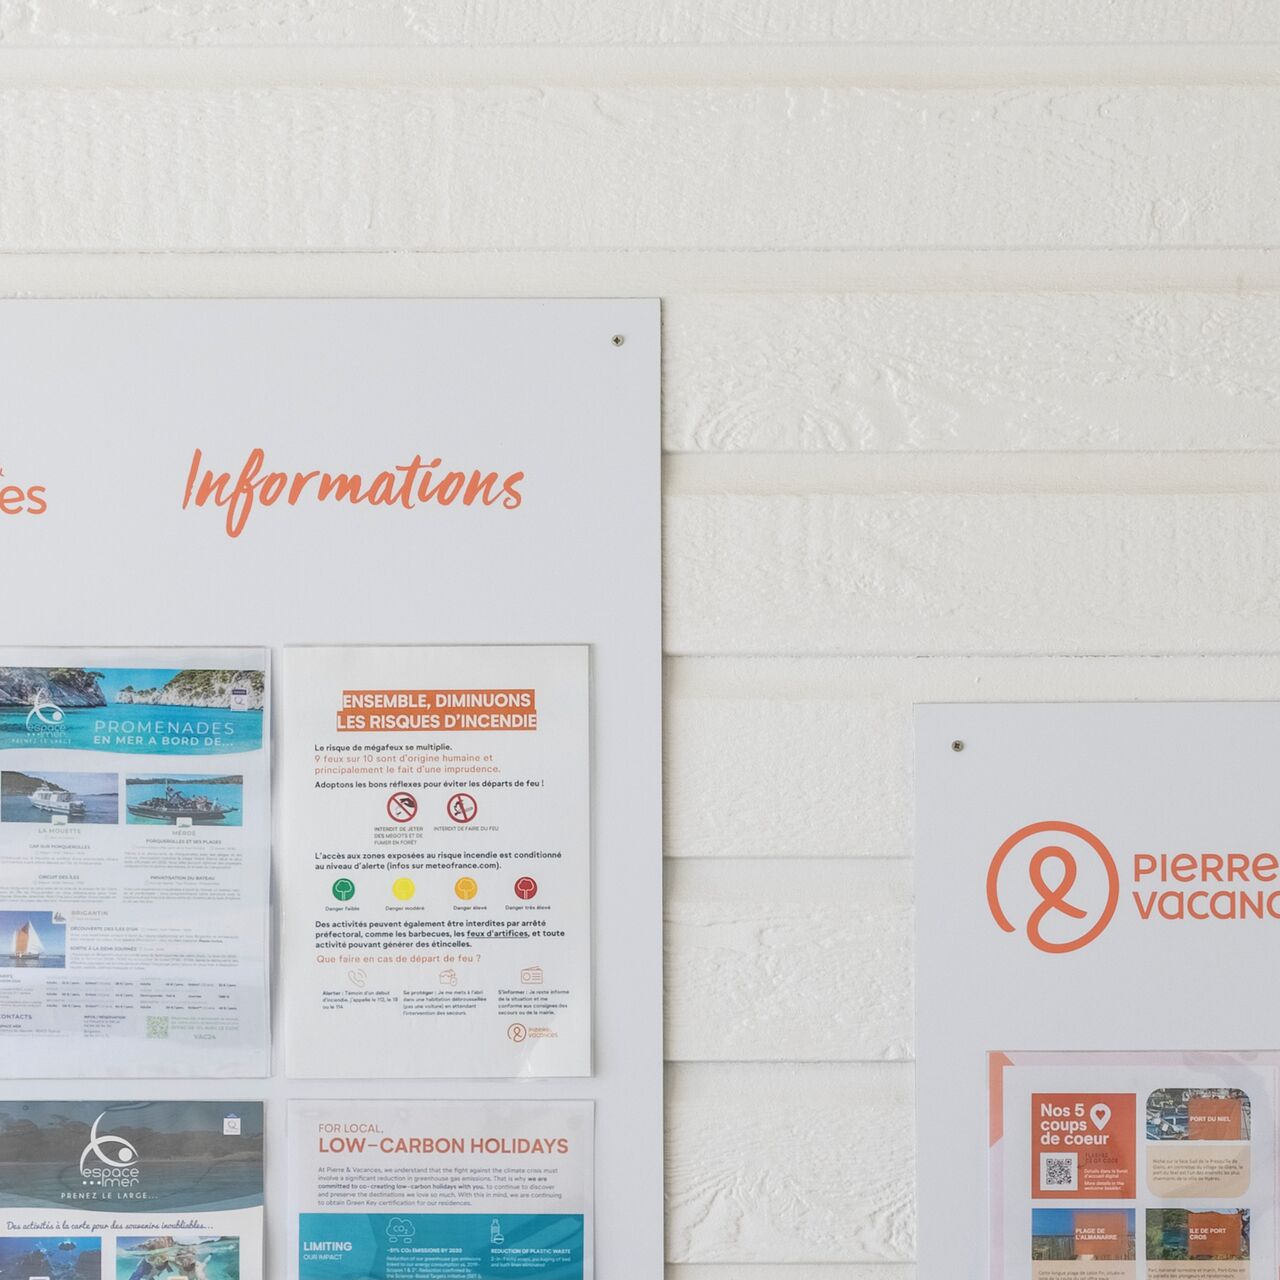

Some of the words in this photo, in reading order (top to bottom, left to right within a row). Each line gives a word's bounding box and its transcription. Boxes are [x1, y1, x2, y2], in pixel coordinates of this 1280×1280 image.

[181, 447, 524, 538] Informations
[343, 694, 431, 710] ENSEMBLE,
[436, 693, 531, 708] DIMINUONS
[95, 720, 235, 735] PROMENADES
[337, 715, 366, 729] LES
[370, 714, 440, 729] RISQUES
[444, 713, 537, 728] D'INCENDIE
[94, 736, 112, 745] EN
[116, 736, 143, 745] MER
[148, 737, 157, 745] A
[162, 737, 199, 746] BORD
[205, 738, 234, 747] DE...
[364, 744, 403, 752] mégafeux
[317, 955, 336, 963] Que
[339, 955, 360, 963] faire
[410, 955, 439, 964] départ
[1040, 1103, 1070, 1117] Nos
[1075, 1103, 1085, 1117] 5
[319, 1124, 341, 1133] FOR
[344, 1124, 383, 1133] LOCAL,
[1040, 1120, 1087, 1134] coups
[1040, 1131, 1060, 1146] de
[1064, 1134, 1109, 1146] coeur
[82, 1168, 140, 1180] espace
[61, 1192, 97, 1200] PRENEZ
[102, 1192, 112, 1200] LE
[118, 1192, 158, 1200] LARGE...
[303, 1242, 352, 1252] LIMITING
